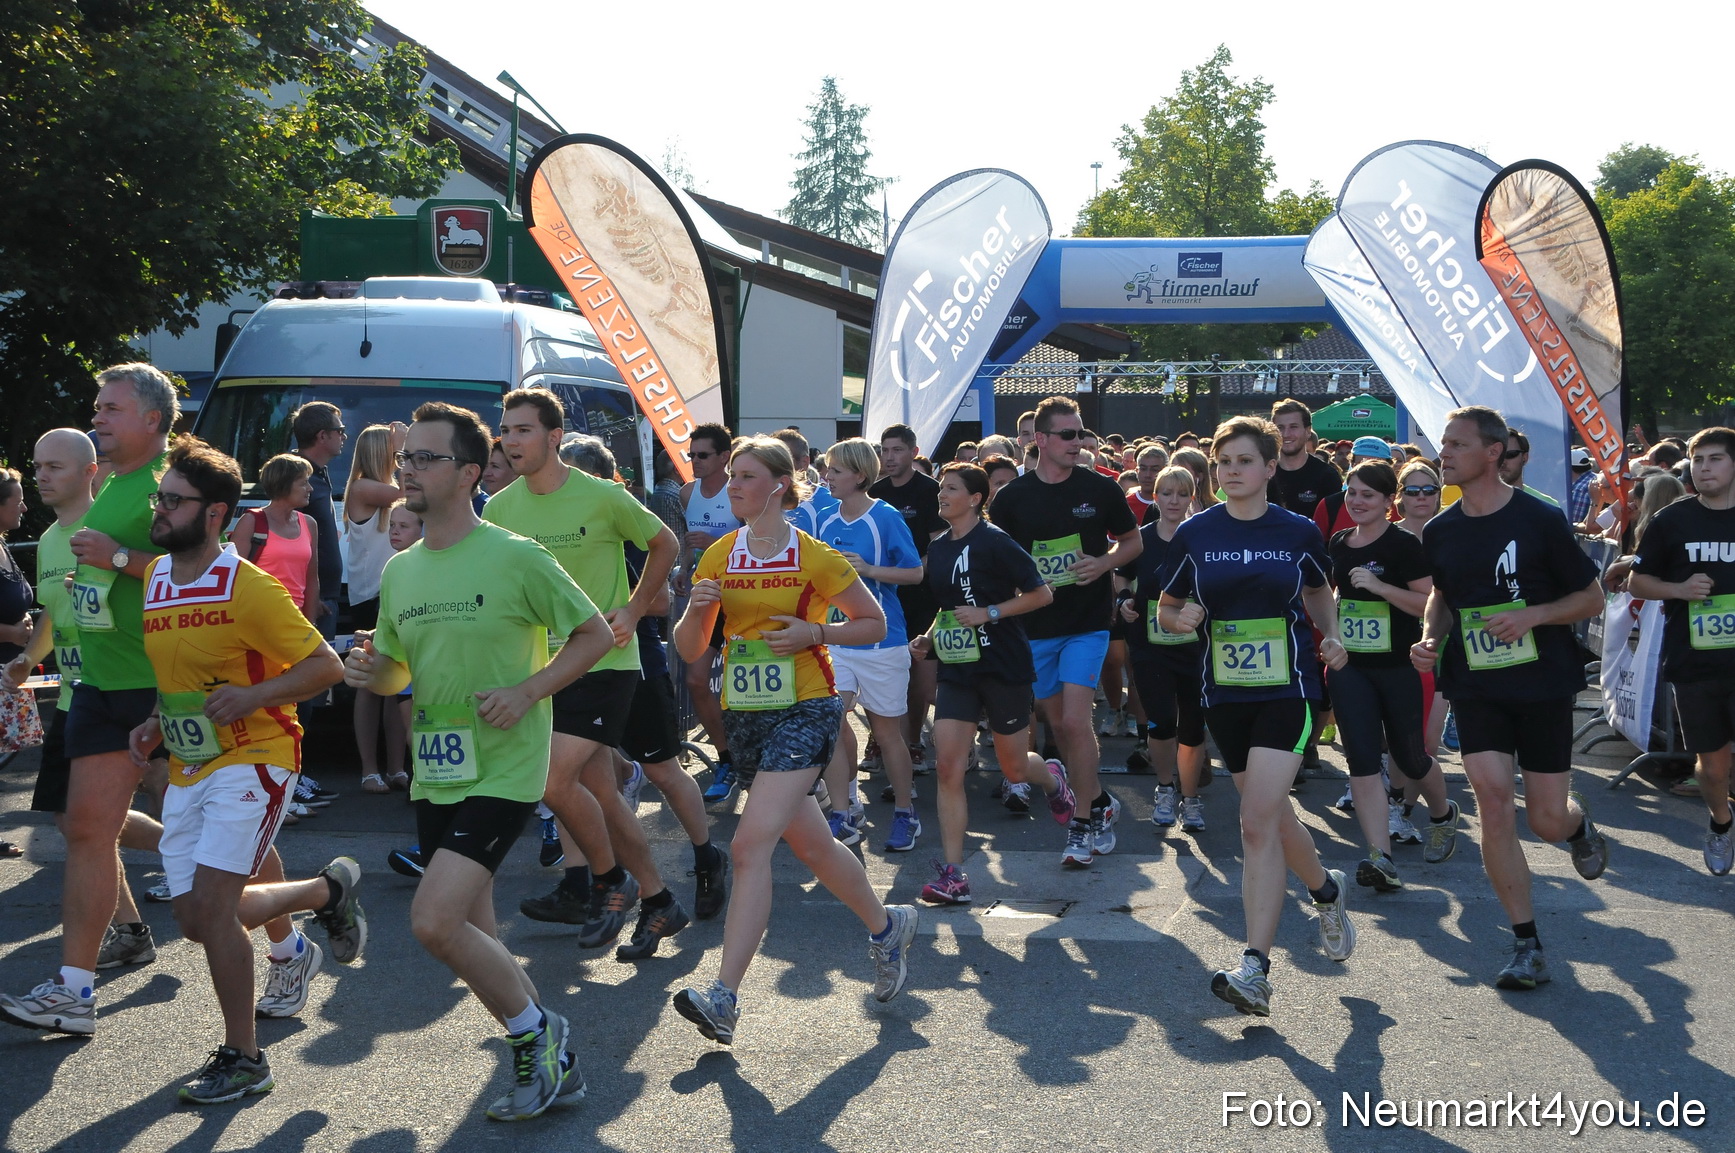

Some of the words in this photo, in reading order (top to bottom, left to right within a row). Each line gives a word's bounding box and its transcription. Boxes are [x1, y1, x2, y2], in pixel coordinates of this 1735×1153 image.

[450, 256, 475, 270] 1628
[914, 204, 1012, 364] Fischer
[1161, 278, 1261, 297] firmenlauf
[950, 235, 1023, 362] AUTOMOBILE
[1038, 552, 1076, 575] 320
[1204, 551, 1241, 562] EURO
[1254, 550, 1292, 562] POLES
[1684, 541, 1735, 563] THU
[723, 578, 756, 590] MAX
[761, 575, 803, 589] BÖGL
[143, 615, 172, 635] MAX
[178, 608, 235, 629] BÖGL
[398, 600, 477, 626] globalconcepts
[1692, 613, 1735, 637] 139
[934, 627, 976, 651] 1052
[1343, 617, 1381, 640] 313
[1221, 641, 1272, 670] 321
[733, 664, 783, 693] 818
[161, 714, 205, 747] 819
[418, 733, 465, 766] 448
